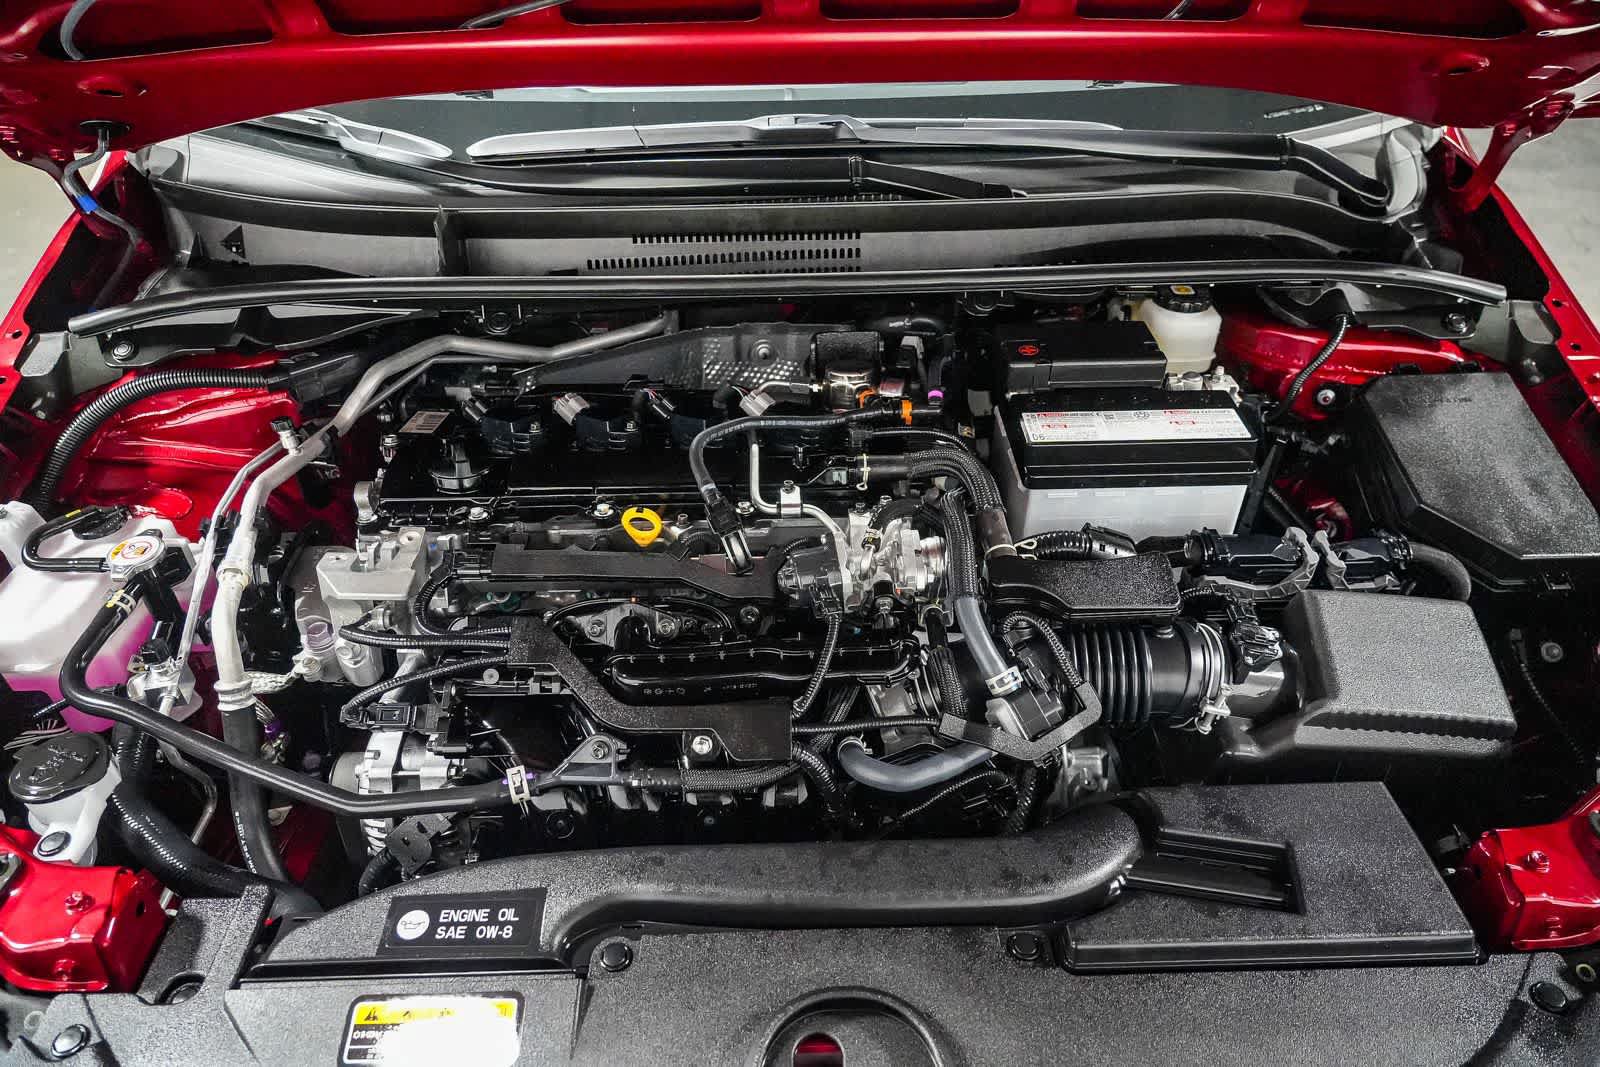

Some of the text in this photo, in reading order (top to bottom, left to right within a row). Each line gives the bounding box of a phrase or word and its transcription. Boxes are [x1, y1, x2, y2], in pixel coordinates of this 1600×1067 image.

[439, 907, 519, 922] ENGINE OIL
[435, 925, 513, 939] SAE 0W-8
